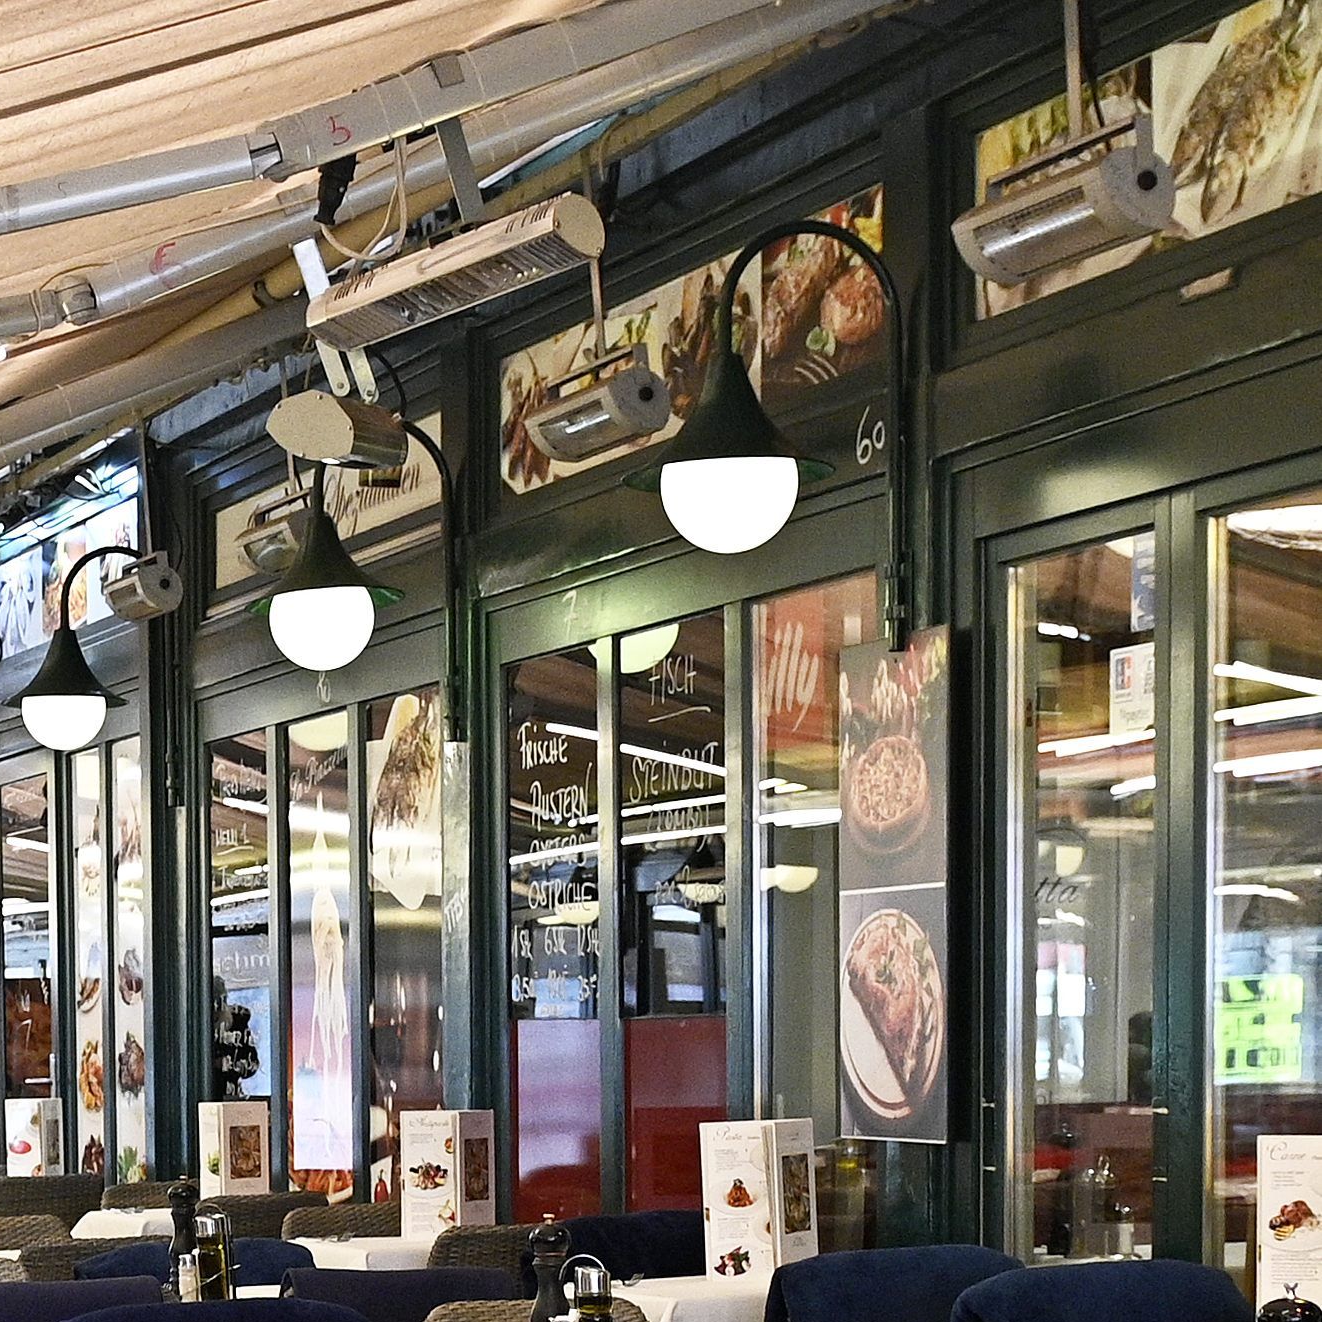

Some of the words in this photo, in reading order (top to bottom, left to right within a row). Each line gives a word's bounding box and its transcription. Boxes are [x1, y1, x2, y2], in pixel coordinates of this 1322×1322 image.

[329, 111, 352, 147] 5
[856, 405, 885, 465] 60
[648, 653, 697, 706] FISCH
[529, 762, 593, 832] AUSTERN
